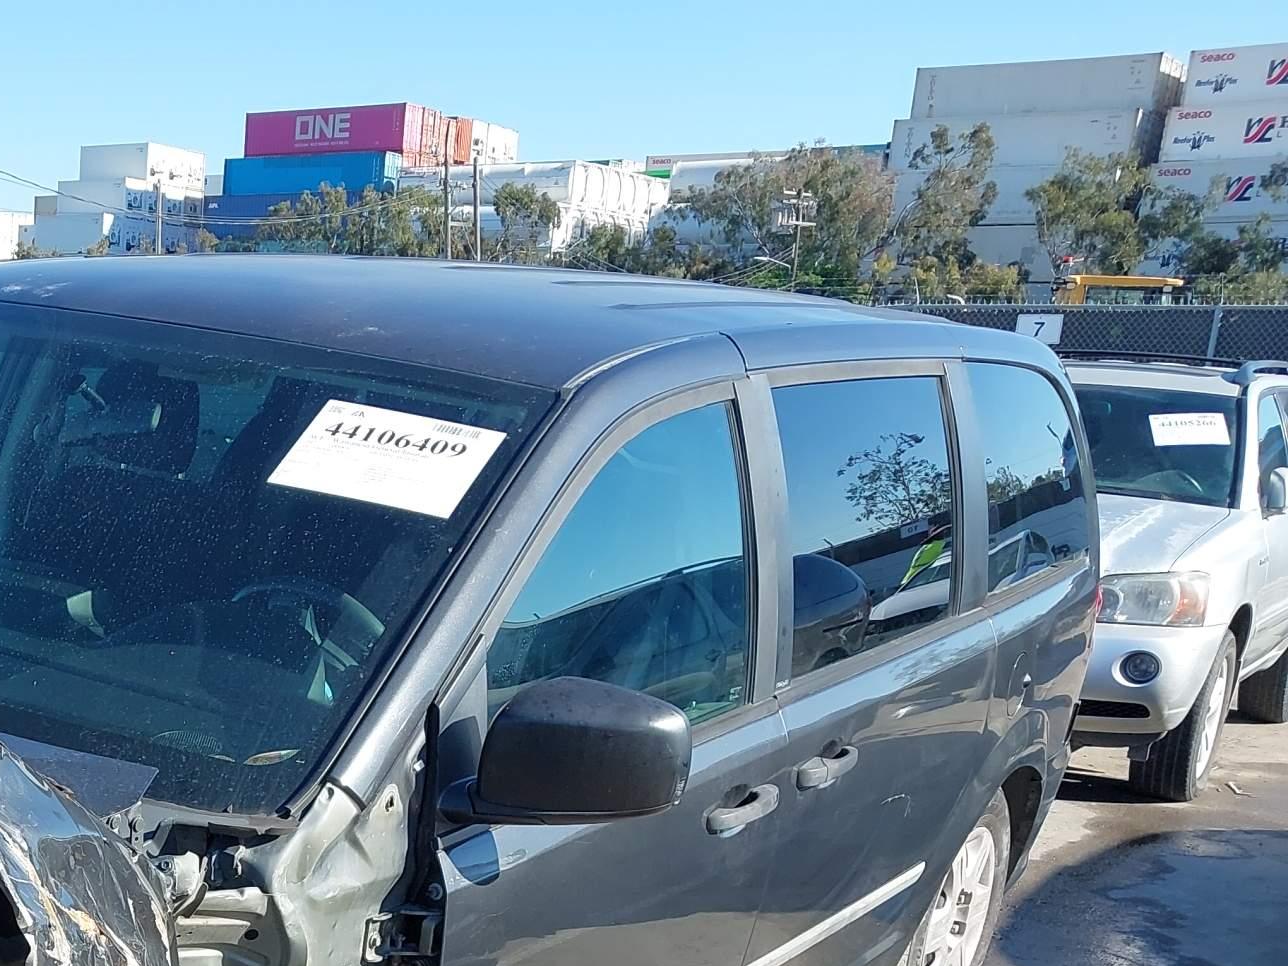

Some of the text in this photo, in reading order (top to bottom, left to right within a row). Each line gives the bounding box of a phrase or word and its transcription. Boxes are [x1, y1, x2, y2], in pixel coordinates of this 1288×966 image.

[1200, 53, 1235, 63] seaco
[1177, 110, 1212, 120] seaco
[295, 113, 351, 140] ONE
[1157, 168, 1191, 177] seaco
[1034, 322, 1045, 337] 7
[325, 421, 467, 458] 44106409
